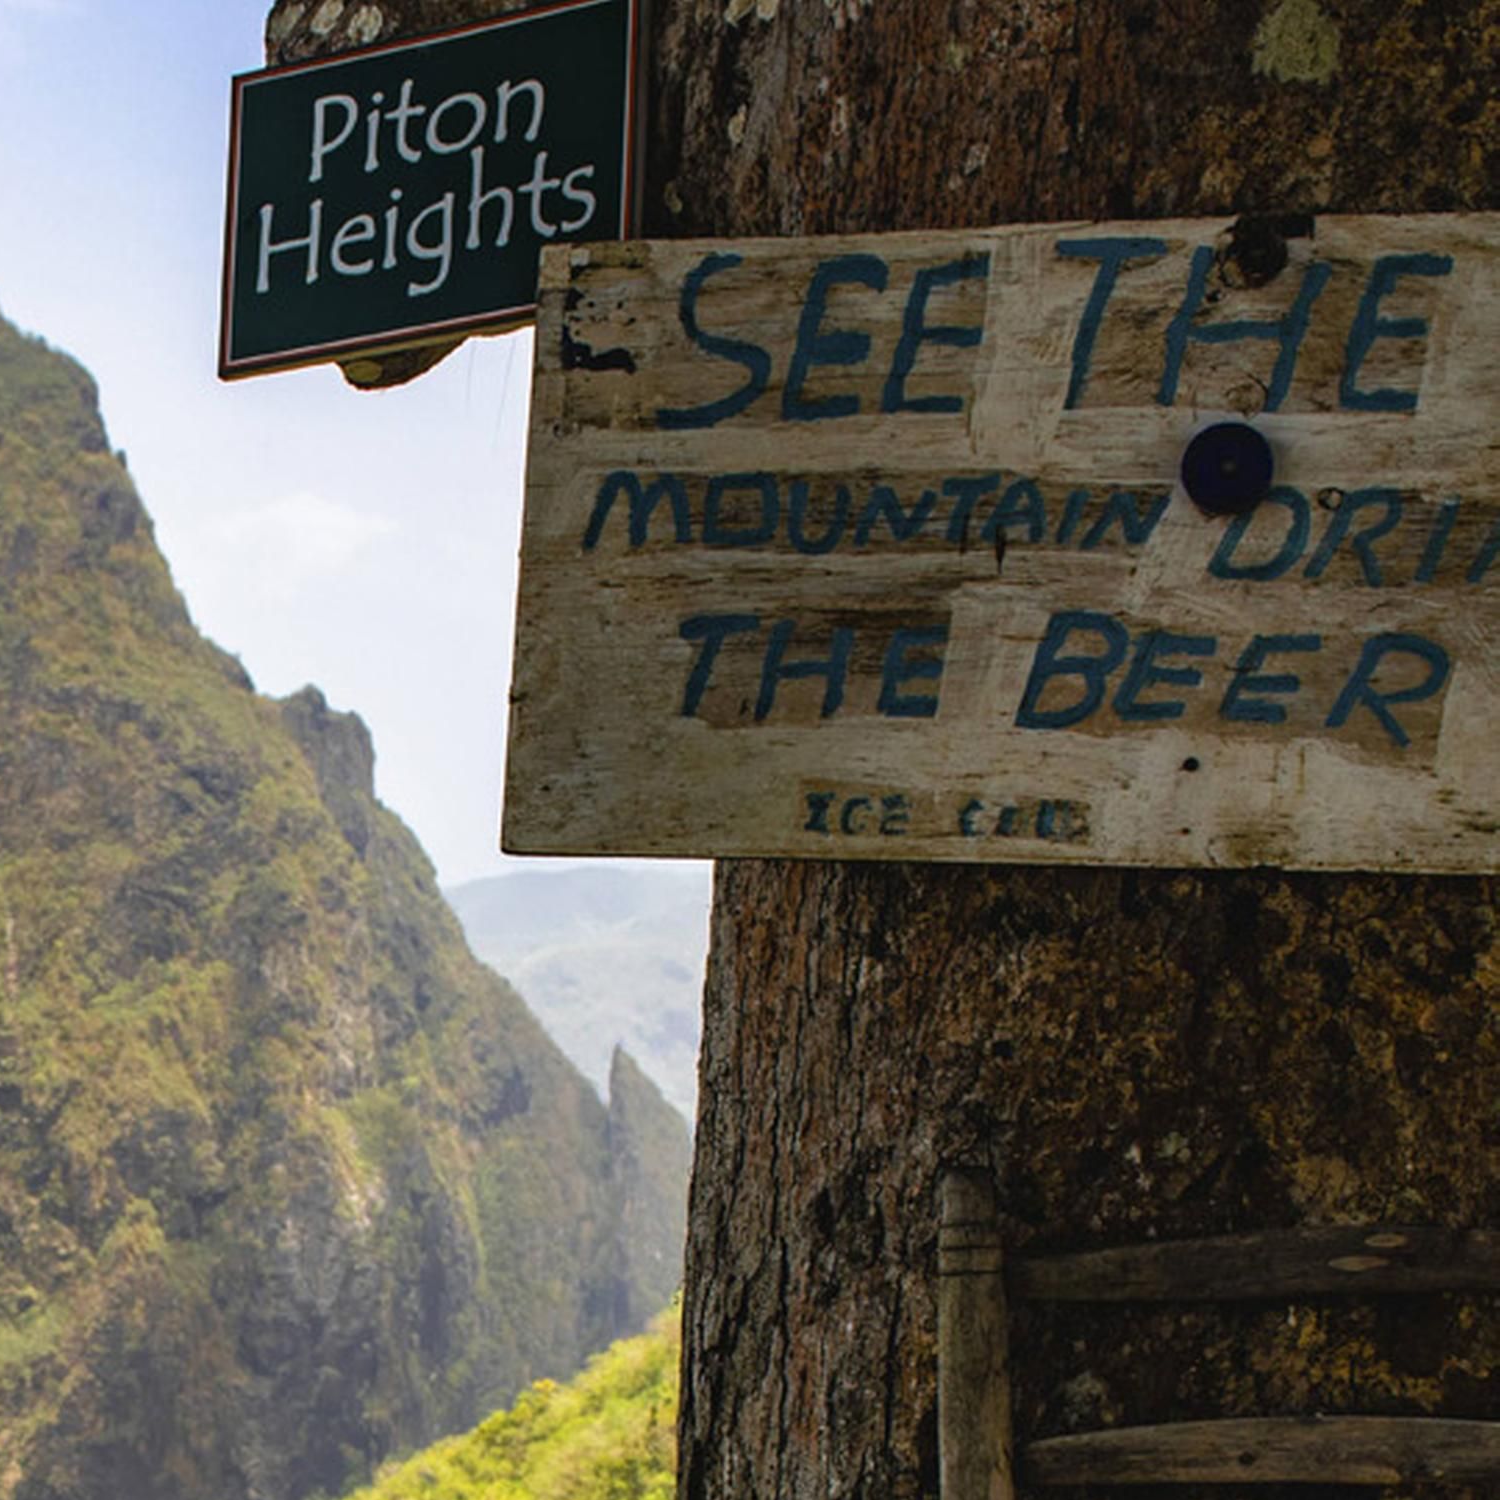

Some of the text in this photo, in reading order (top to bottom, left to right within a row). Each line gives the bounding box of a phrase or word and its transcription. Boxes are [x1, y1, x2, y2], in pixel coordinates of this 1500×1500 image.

[308, 78, 546, 183] Piton
[255, 145, 597, 297] Heights
[655, 236, 1455, 430] SEE THE
[581, 470, 1172, 556] MOUNTAIN
[678, 609, 1450, 748] THE BEER
[803, 791, 912, 837] ICE
